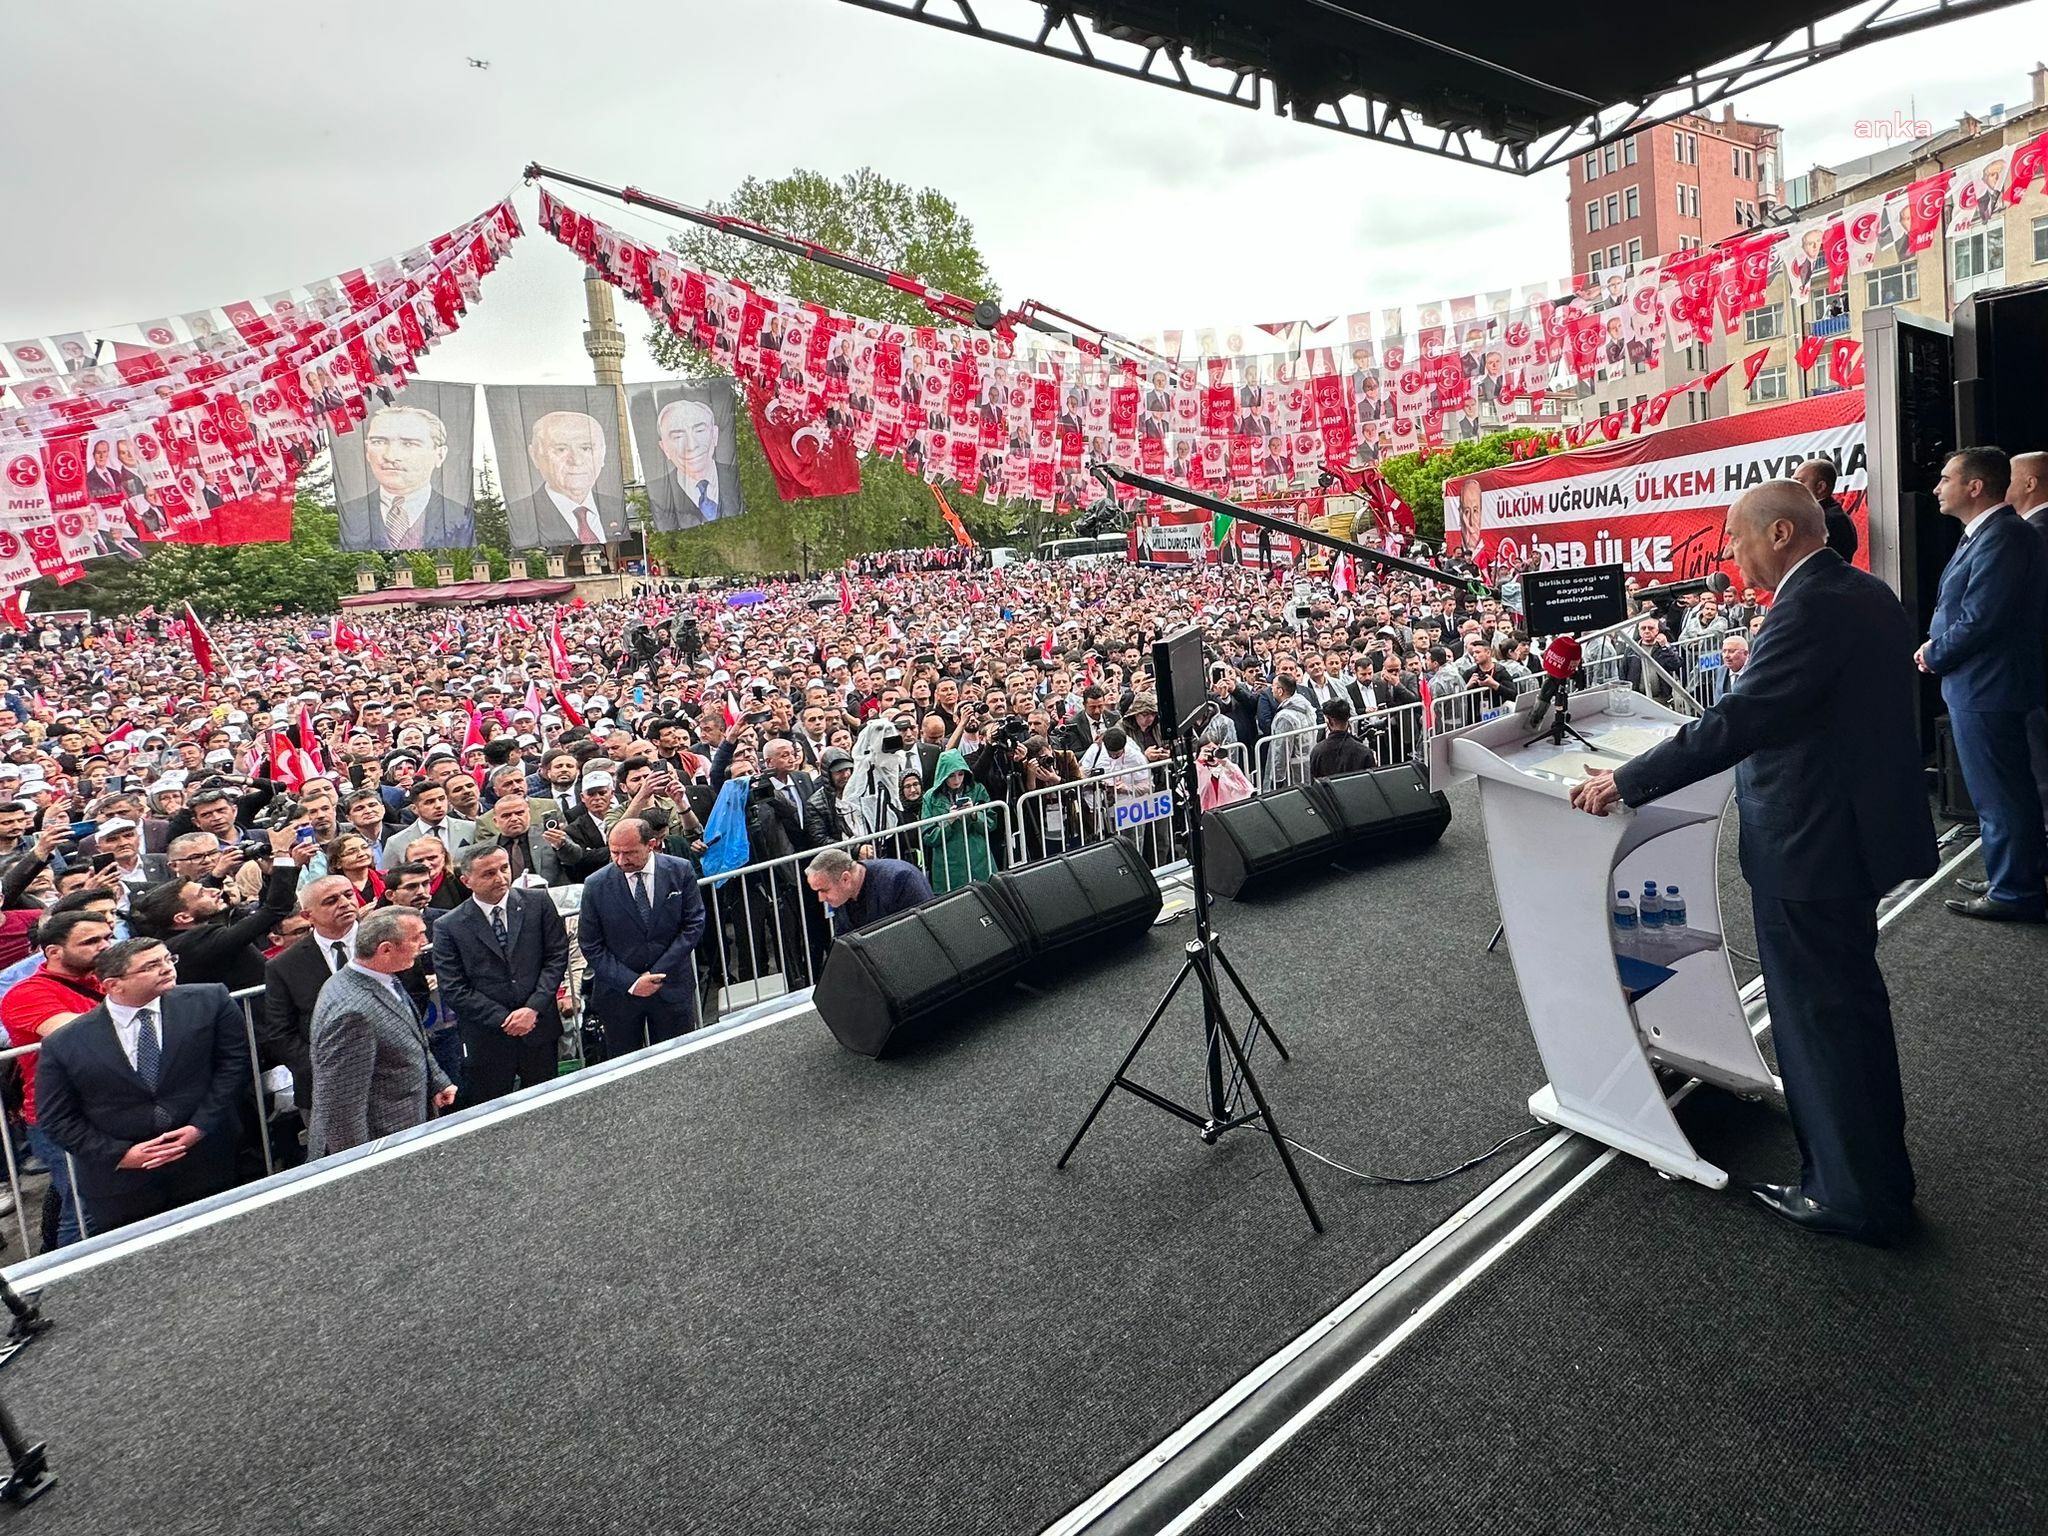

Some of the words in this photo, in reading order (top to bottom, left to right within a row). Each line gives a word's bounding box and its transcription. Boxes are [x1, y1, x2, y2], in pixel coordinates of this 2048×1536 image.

[1954, 221, 1972, 232] MH
[1917, 232, 1934, 245] MH
[1728, 315, 1741, 328] MH
[1678, 329, 1691, 343] MH
[1580, 363, 1595, 374] MH
[341, 382, 357, 392] MH
[1402, 402, 1423, 412] MHP
[1442, 397, 1462, 407] MHP
[1322, 416, 1342, 425] MHP
[1502, 412, 1515, 422] MH
[1397, 443, 1415, 451] MHP
[207, 454, 233, 465] MHP
[1497, 491, 1544, 519] ÜLKÜM
[1549, 483, 1629, 513] UĞRUNA,
[1635, 468, 1715, 503] ÜLKEM
[1724, 443, 1867, 491] HAYRNA
[55, 491, 83, 504] MHP
[8, 499, 45, 510] MHP
[104, 513, 127, 525] MH
[1594, 529, 1674, 573] ÜLKE
[40, 558, 64, 570] MHP
[4, 567, 31, 582] MHP
[1539, 578, 1571, 587] birlikte
[1573, 576, 1597, 584] sevgi
[1556, 586, 1594, 595] saygıyla
[1546, 594, 1608, 606] selamlıyorum.
[1563, 614, 1592, 622] Bizleri
